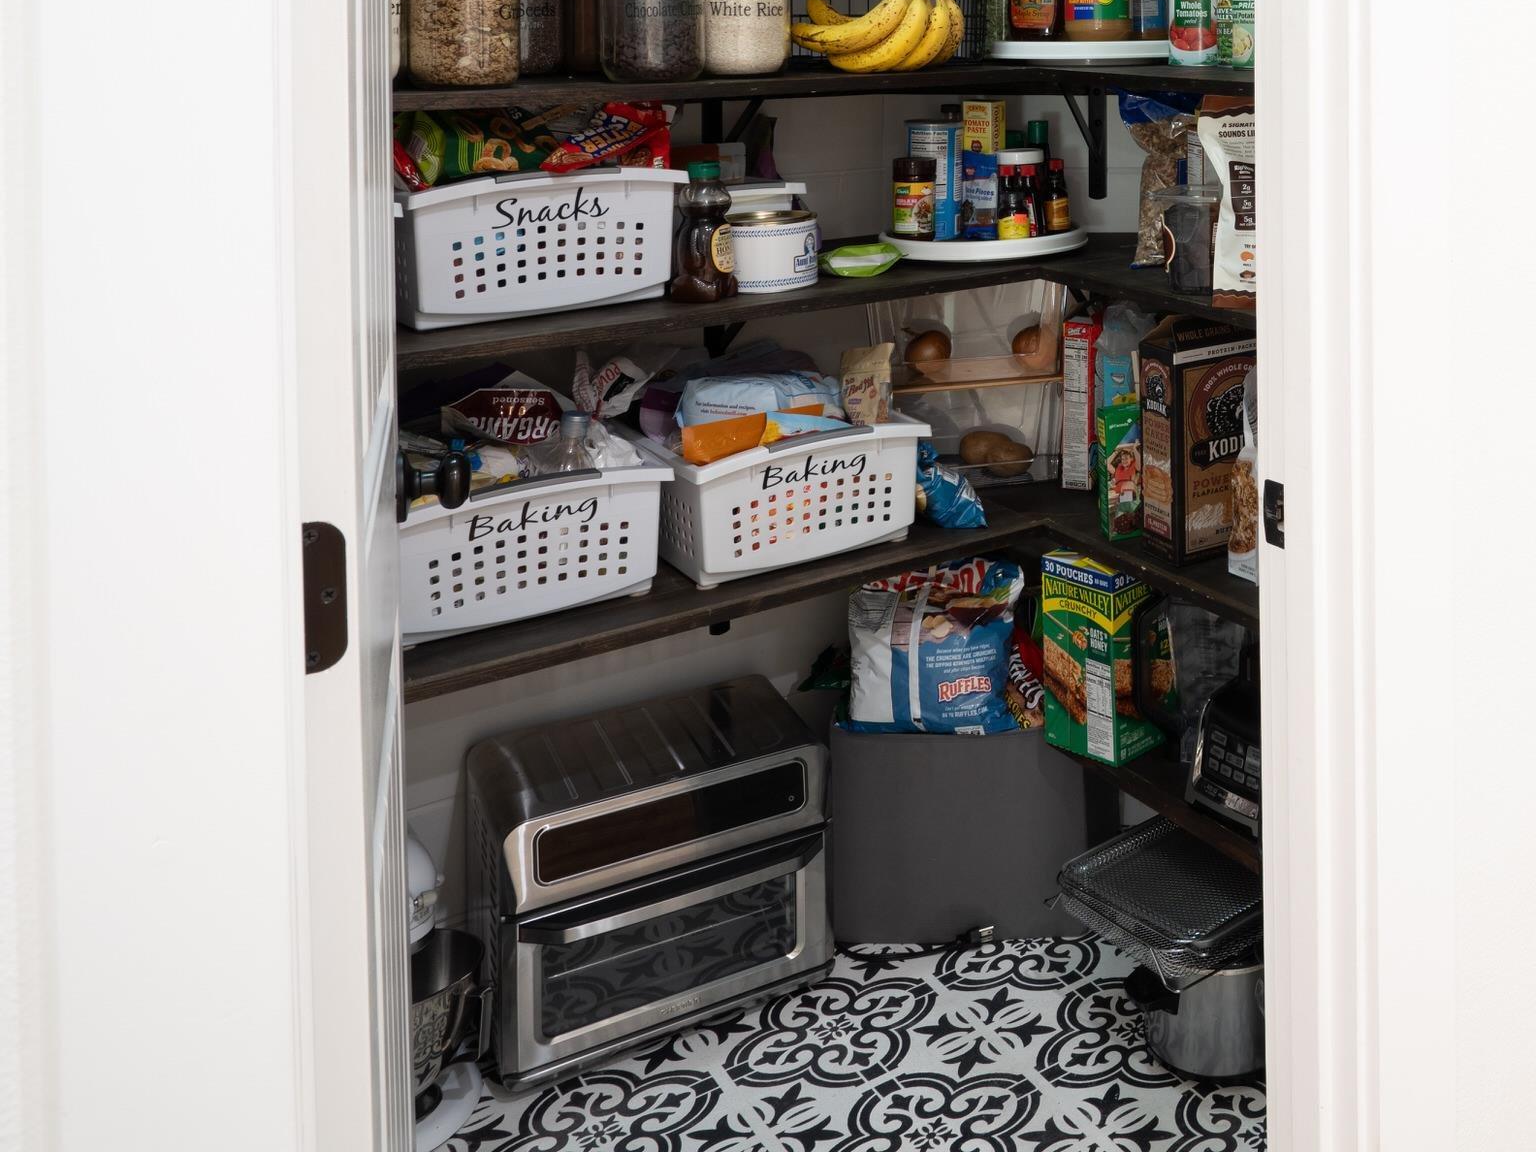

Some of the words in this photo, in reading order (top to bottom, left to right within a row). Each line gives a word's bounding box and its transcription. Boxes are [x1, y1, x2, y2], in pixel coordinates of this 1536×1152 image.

[624, 1, 677, 19] Chocolate
[710, 1, 752, 17] White
[756, 2, 784, 17] Rice
[1176, 9, 1208, 18] Tomatoes
[1180, 1, 1202, 10] Whole
[965, 119, 990, 127] TOMATO
[967, 126, 987, 135] PASTE
[1218, 129, 1246, 138] SOUNDS
[491, 187, 610, 231] Snacks
[1203, 375, 1218, 392] 100%
[1216, 362, 1242, 378] WHOLE
[491, 396, 545, 406] Seasoned
[1208, 433, 1244, 462] KODI
[761, 453, 867, 490] Baking
[1193, 472, 1231, 491] POWE
[465, 496, 599, 541] Baking
[1044, 560, 1055, 573] 30
[1055, 563, 1094, 586] POUCHES
[1114, 575, 1124, 589] 30
[1044, 577, 1079, 601] NATURE
[1078, 588, 1110, 618] VALLEY
[1058, 600, 1098, 620] CRUNCHY
[1089, 626, 1103, 641] OATS
[1090, 637, 1108, 653] HONEY
[939, 676, 991, 702] RUFFLES
